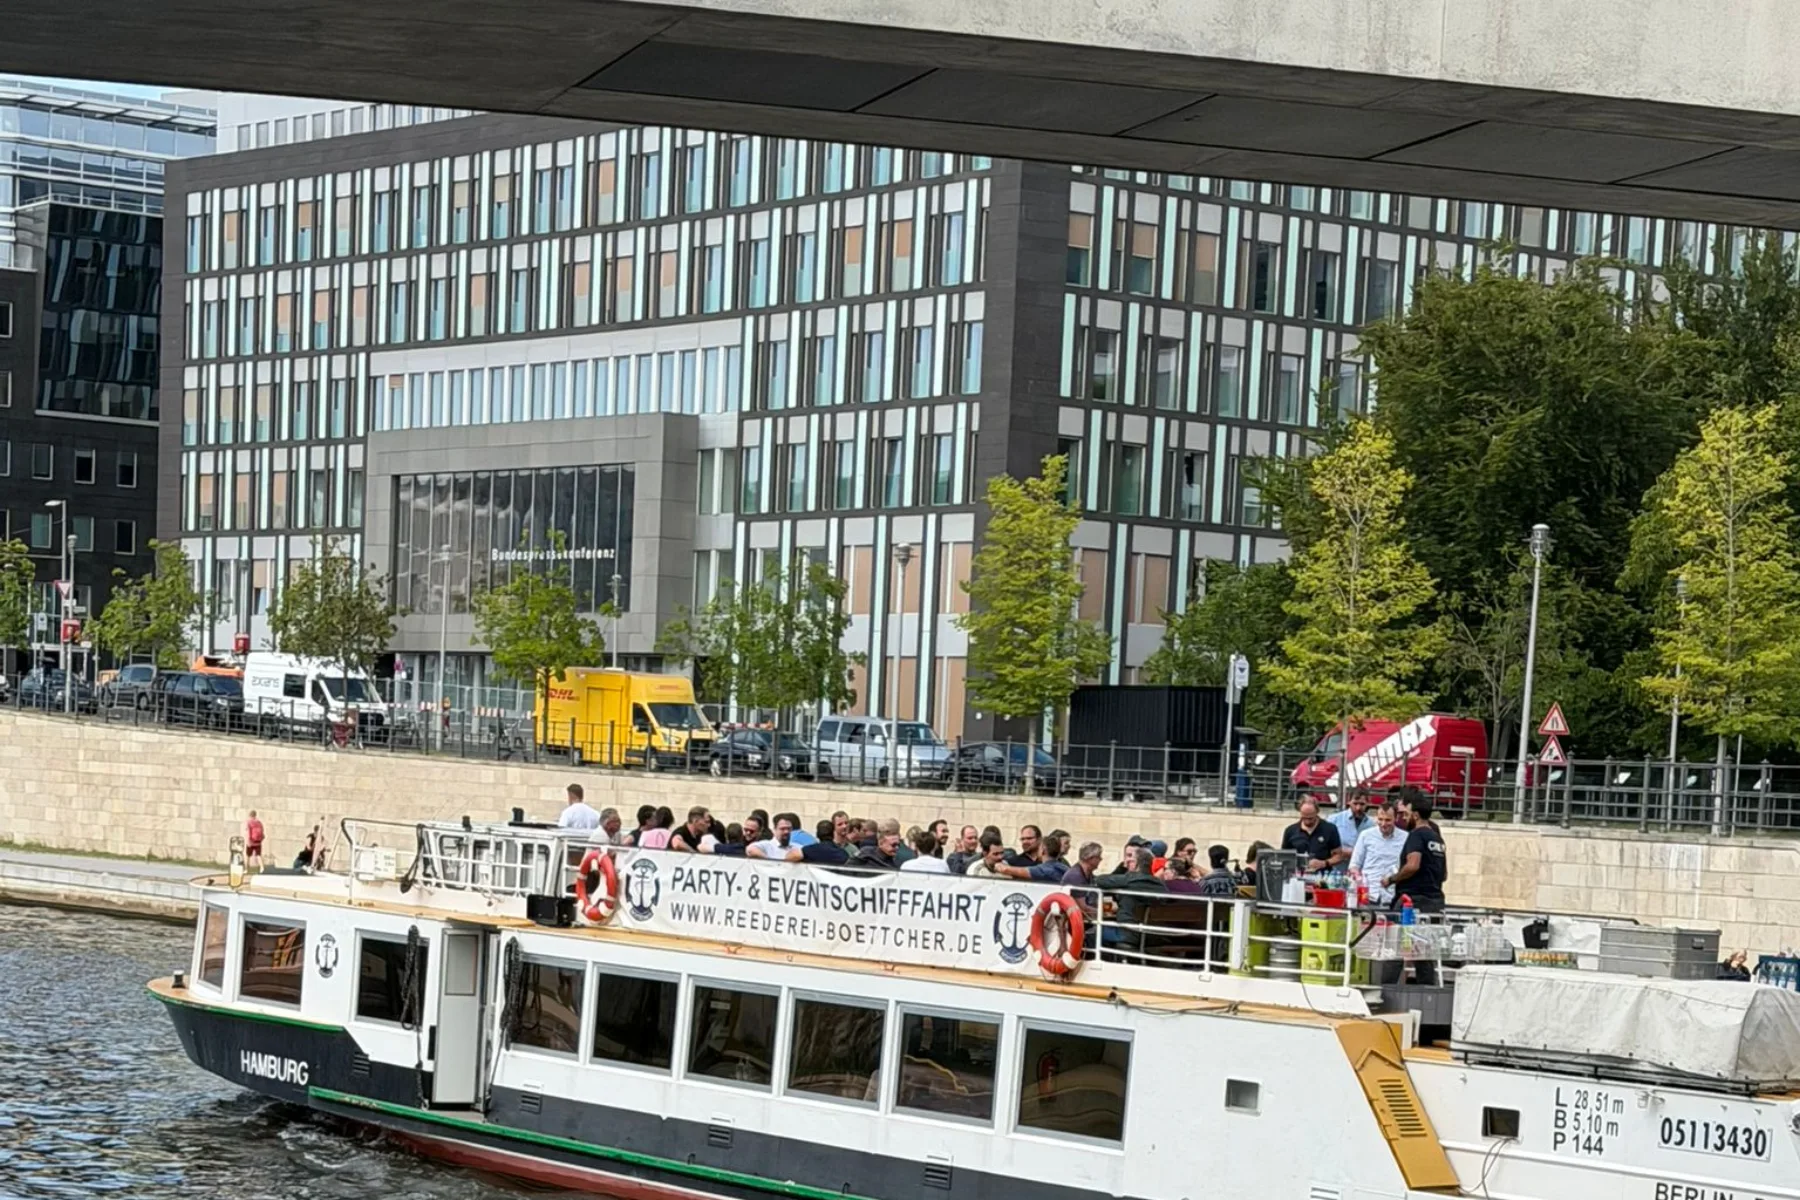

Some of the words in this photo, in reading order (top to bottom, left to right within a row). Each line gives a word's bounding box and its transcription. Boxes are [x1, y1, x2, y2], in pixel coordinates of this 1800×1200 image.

[549, 688, 576, 701] DHL
[671, 866, 743, 898] PARTY-
[748, 873, 761, 901] &
[768, 876, 987, 923] EVENTSCHIFFFAHRT
[670, 901, 983, 955] WWW.REEDEREI-BOETTCHER.DE
[240, 1049, 309, 1086] HAMBURG
[1555, 1086, 1568, 1108] L
[1612, 1099, 1624, 1114] m
[1554, 1108, 1567, 1129] B
[1606, 1121, 1619, 1137] m
[1660, 1117, 1767, 1157] 05113430
[1553, 1131, 1566, 1151] P
[1572, 1133, 1604, 1156] 144
